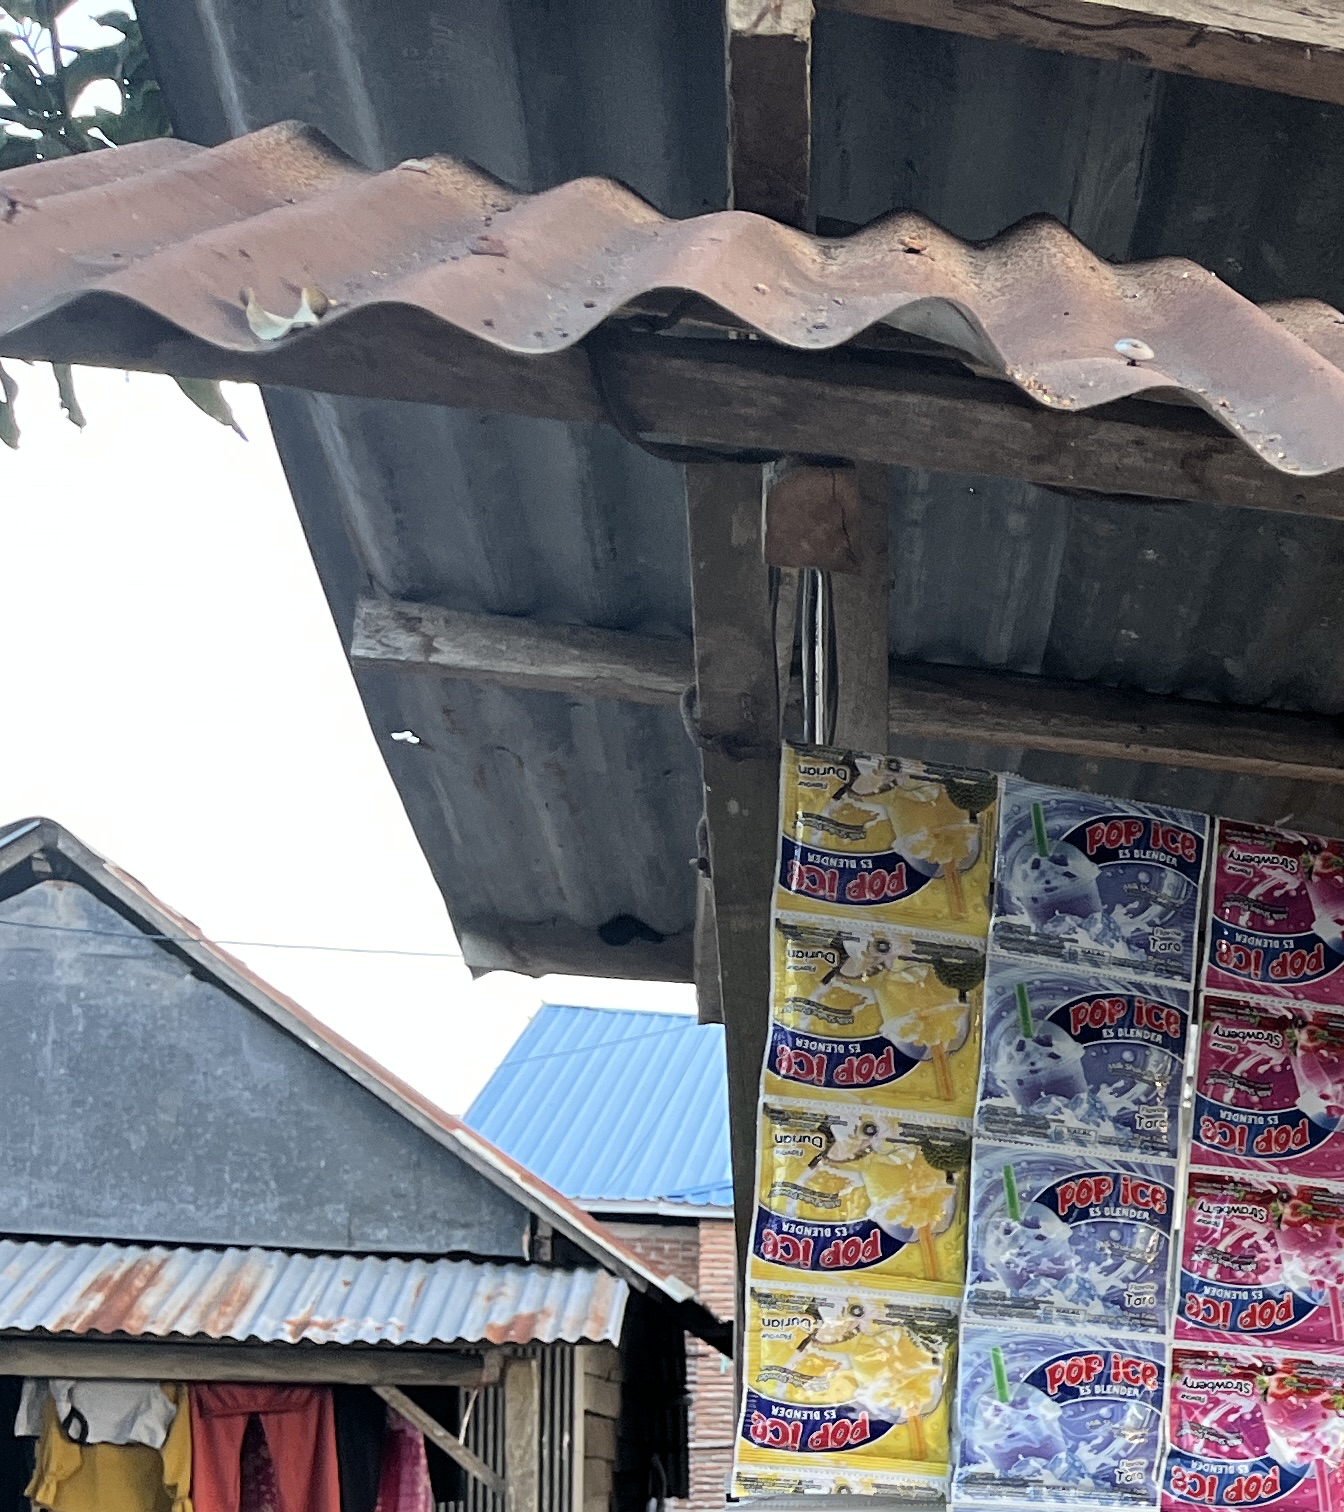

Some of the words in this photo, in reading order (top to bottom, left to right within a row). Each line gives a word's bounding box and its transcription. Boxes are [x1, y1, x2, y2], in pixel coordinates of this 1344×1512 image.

[797, 764, 849, 782] Durian
[1226, 848, 1300, 874] Strawberry
[1149, 937, 1184, 955] Taro
[786, 948, 838, 966] Durian
[1212, 1024, 1286, 1049] Strawberry
[774, 1134, 823, 1150] Durian
[1125, 1292, 1157, 1307] Taro
[761, 1317, 811, 1333] Durian
[1181, 1373, 1252, 1396] Strawberry
